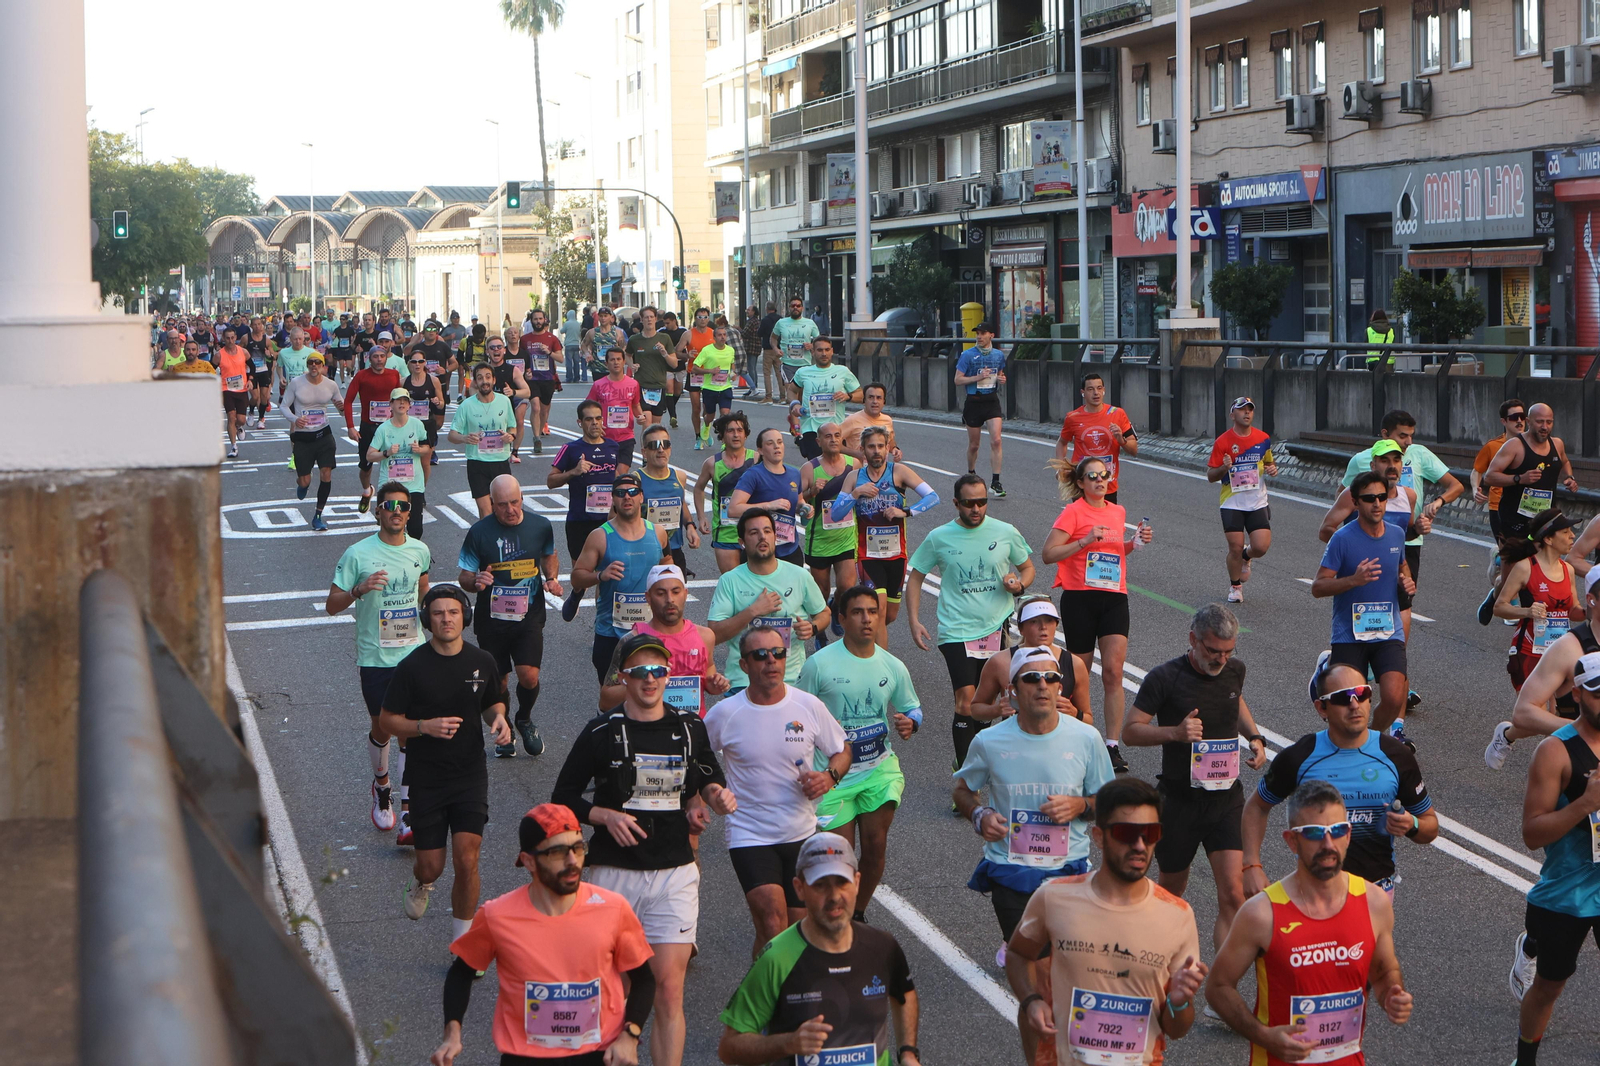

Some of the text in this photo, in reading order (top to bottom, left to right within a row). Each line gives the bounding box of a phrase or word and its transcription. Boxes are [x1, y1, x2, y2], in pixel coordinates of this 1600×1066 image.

[1234, 184, 1268, 204] AUTOCLIMA
[1290, 179, 1300, 195] S.L.
[1028, 226, 1044, 239] TATTOO
[860, 725, 884, 737] ZURICH
[646, 777, 664, 785] 9951
[1031, 834, 1050, 842] 7506
[1066, 941, 1094, 949] MEDIA
[1307, 941, 1337, 950] DEPORTIVO
[1140, 950, 1165, 966] 2022
[1290, 946, 1348, 967] OZONO
[1087, 967, 1116, 976] LABORAL
[553, 986, 593, 998] ZURICH
[1101, 999, 1143, 1012] ZURICH
[1320, 996, 1357, 1010] ZURICH
[553, 1011, 578, 1020] 8587
[551, 1024, 580, 1033] VÍCTOR
[1098, 1023, 1123, 1035] 7922
[1319, 1022, 1342, 1033] 8127
[1079, 1036, 1136, 1050] NACHO MF 97
[825, 1053, 866, 1066] ZURICH
